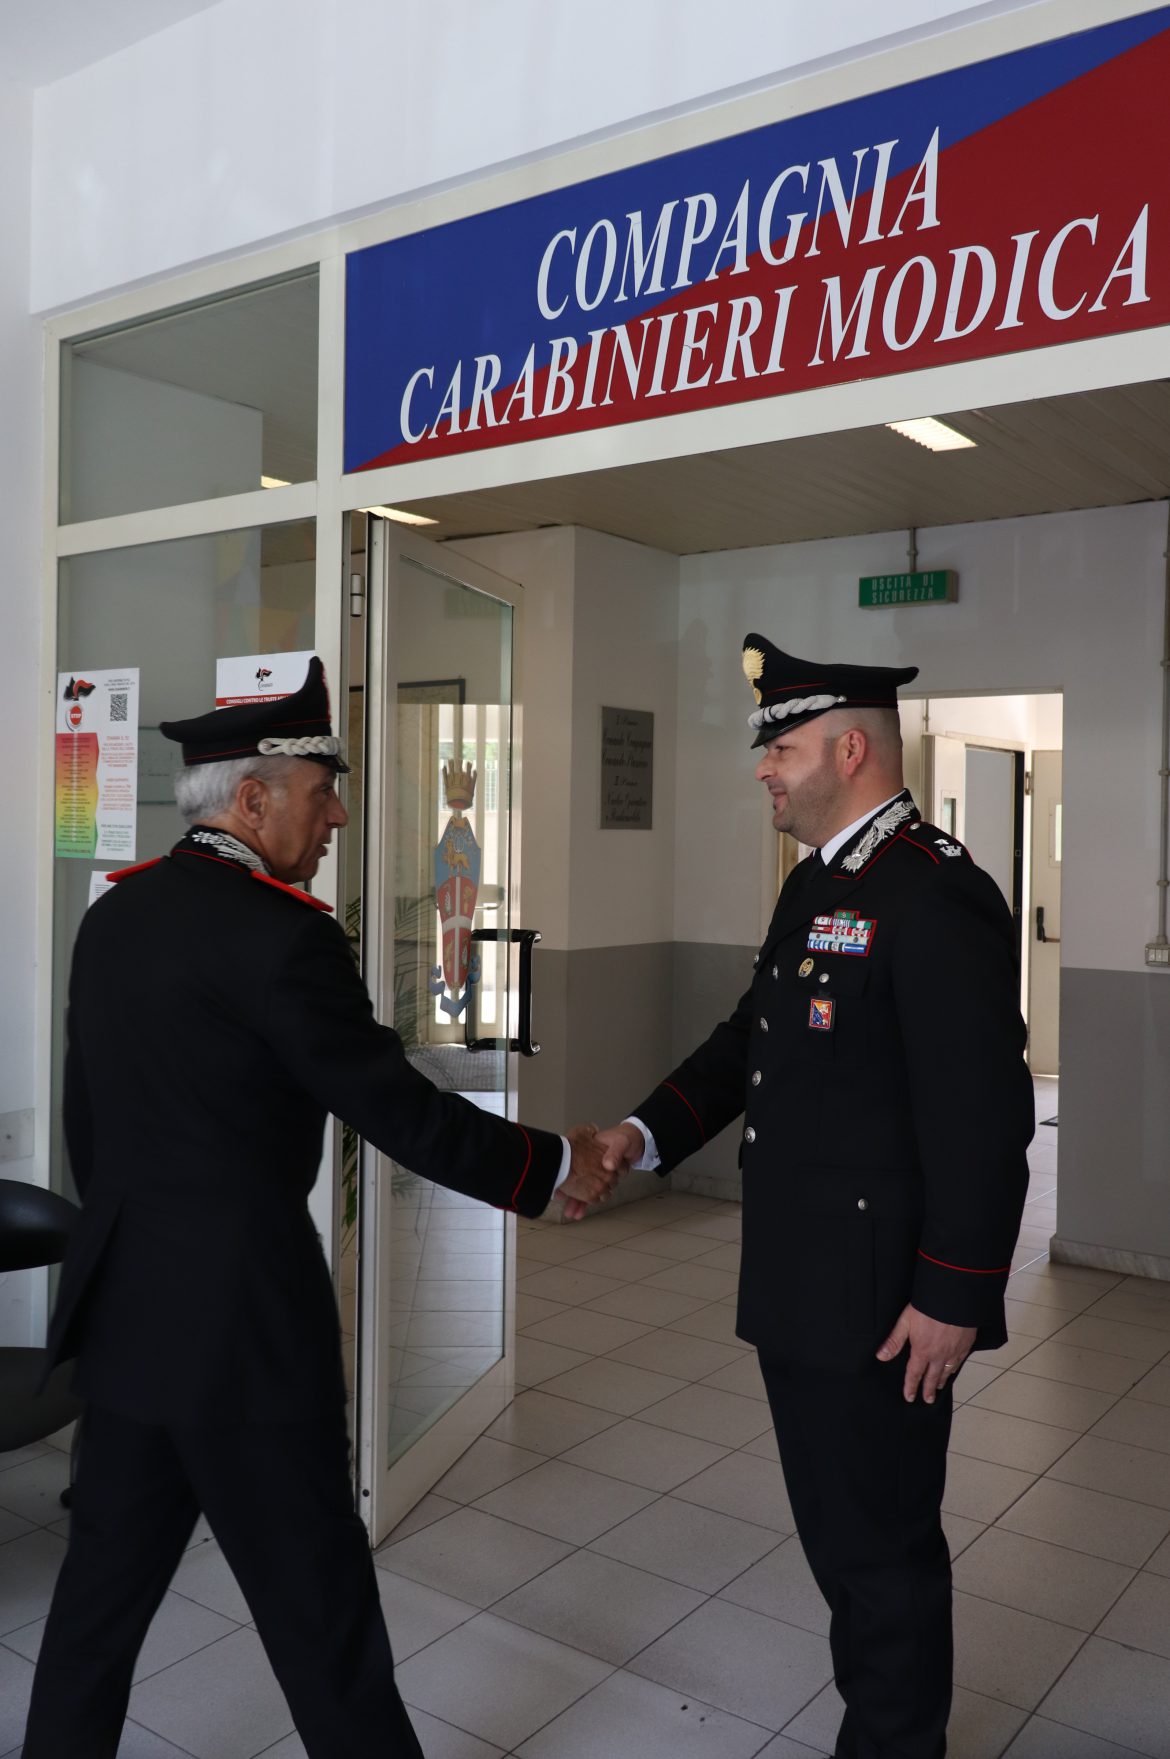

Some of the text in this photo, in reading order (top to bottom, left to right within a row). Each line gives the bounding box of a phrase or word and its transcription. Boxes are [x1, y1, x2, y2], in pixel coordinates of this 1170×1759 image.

[536, 126, 941, 321] COMPAGNIA
[399, 203, 1151, 444] CARABINIERI MODICA
[872, 573, 934, 591] USCITA DI
[872, 587, 934, 604] SICUREZZA
